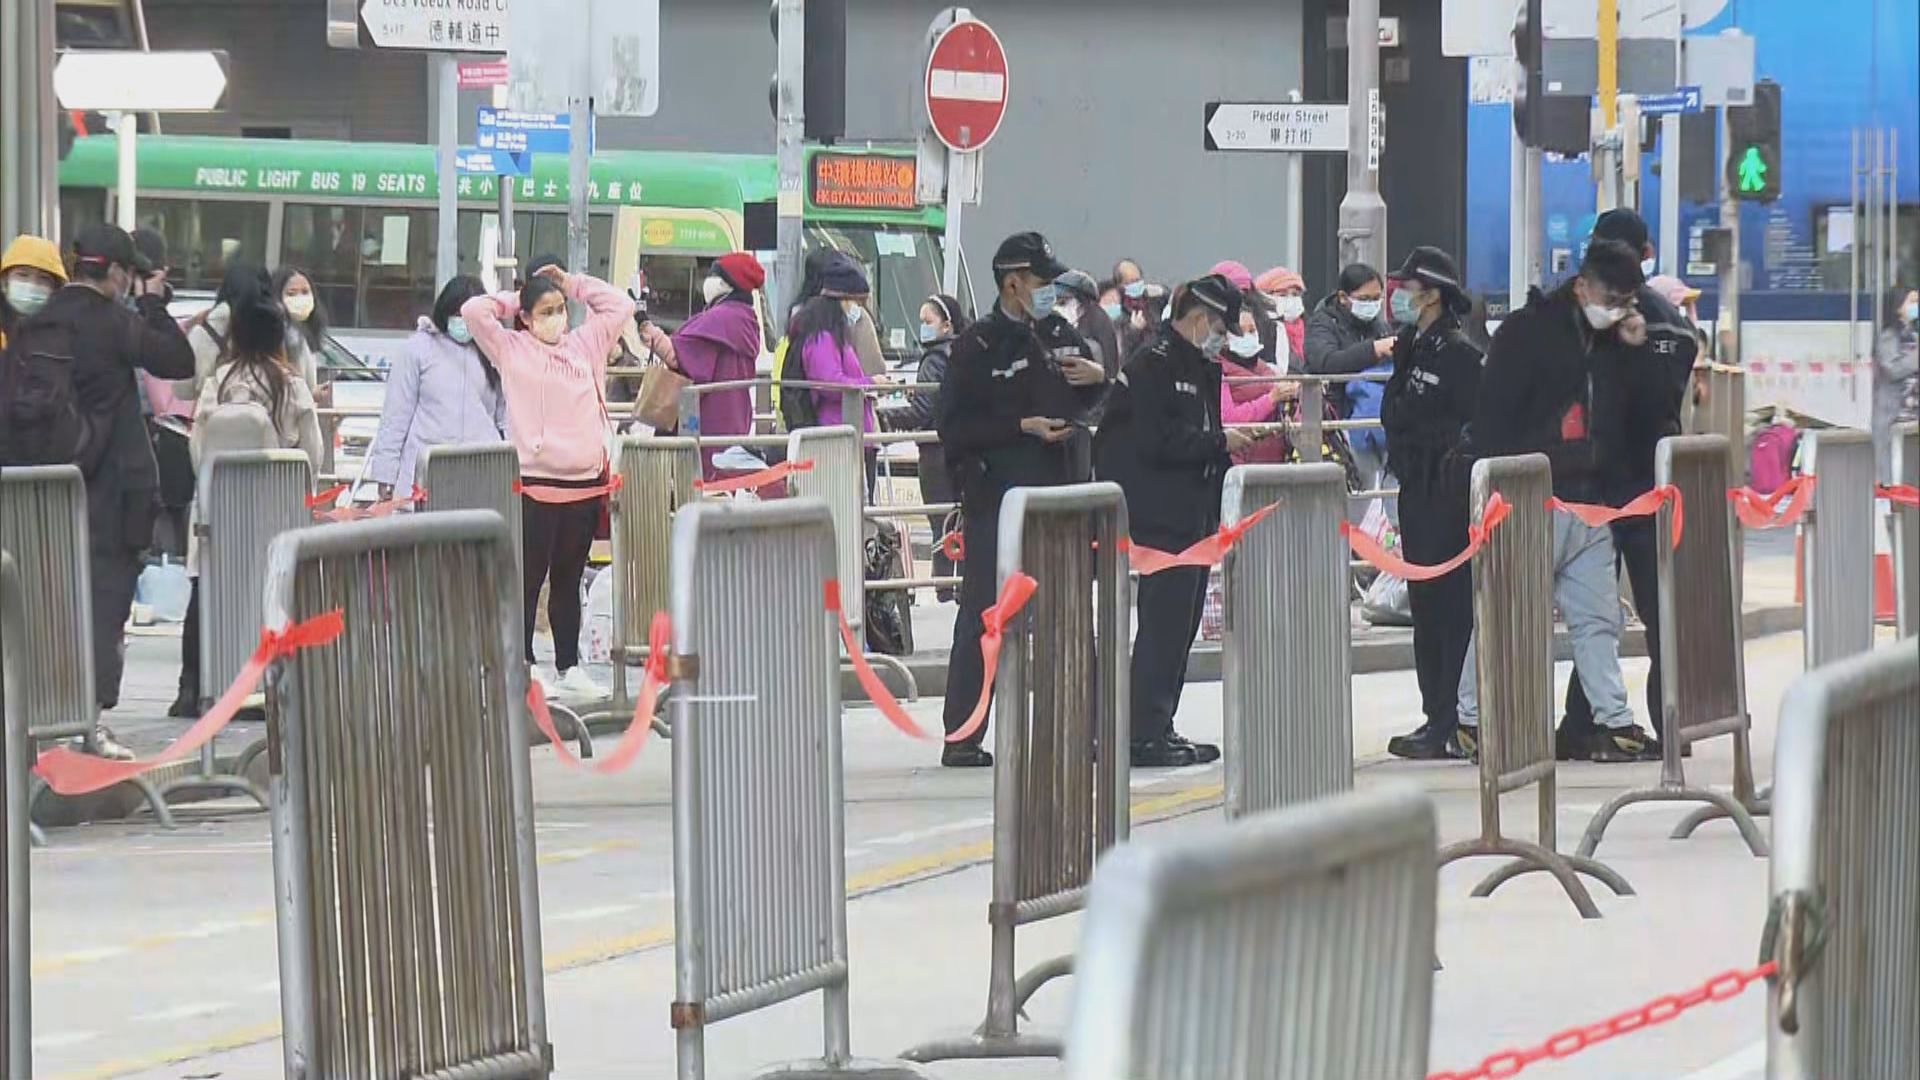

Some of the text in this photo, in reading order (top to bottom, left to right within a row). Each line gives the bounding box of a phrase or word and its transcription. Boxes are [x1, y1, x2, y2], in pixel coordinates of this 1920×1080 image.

[1252, 110, 1329, 123] Pedder Street
[196, 167, 426, 192] PUBLIC LIGHT BUS 19 SEATS
